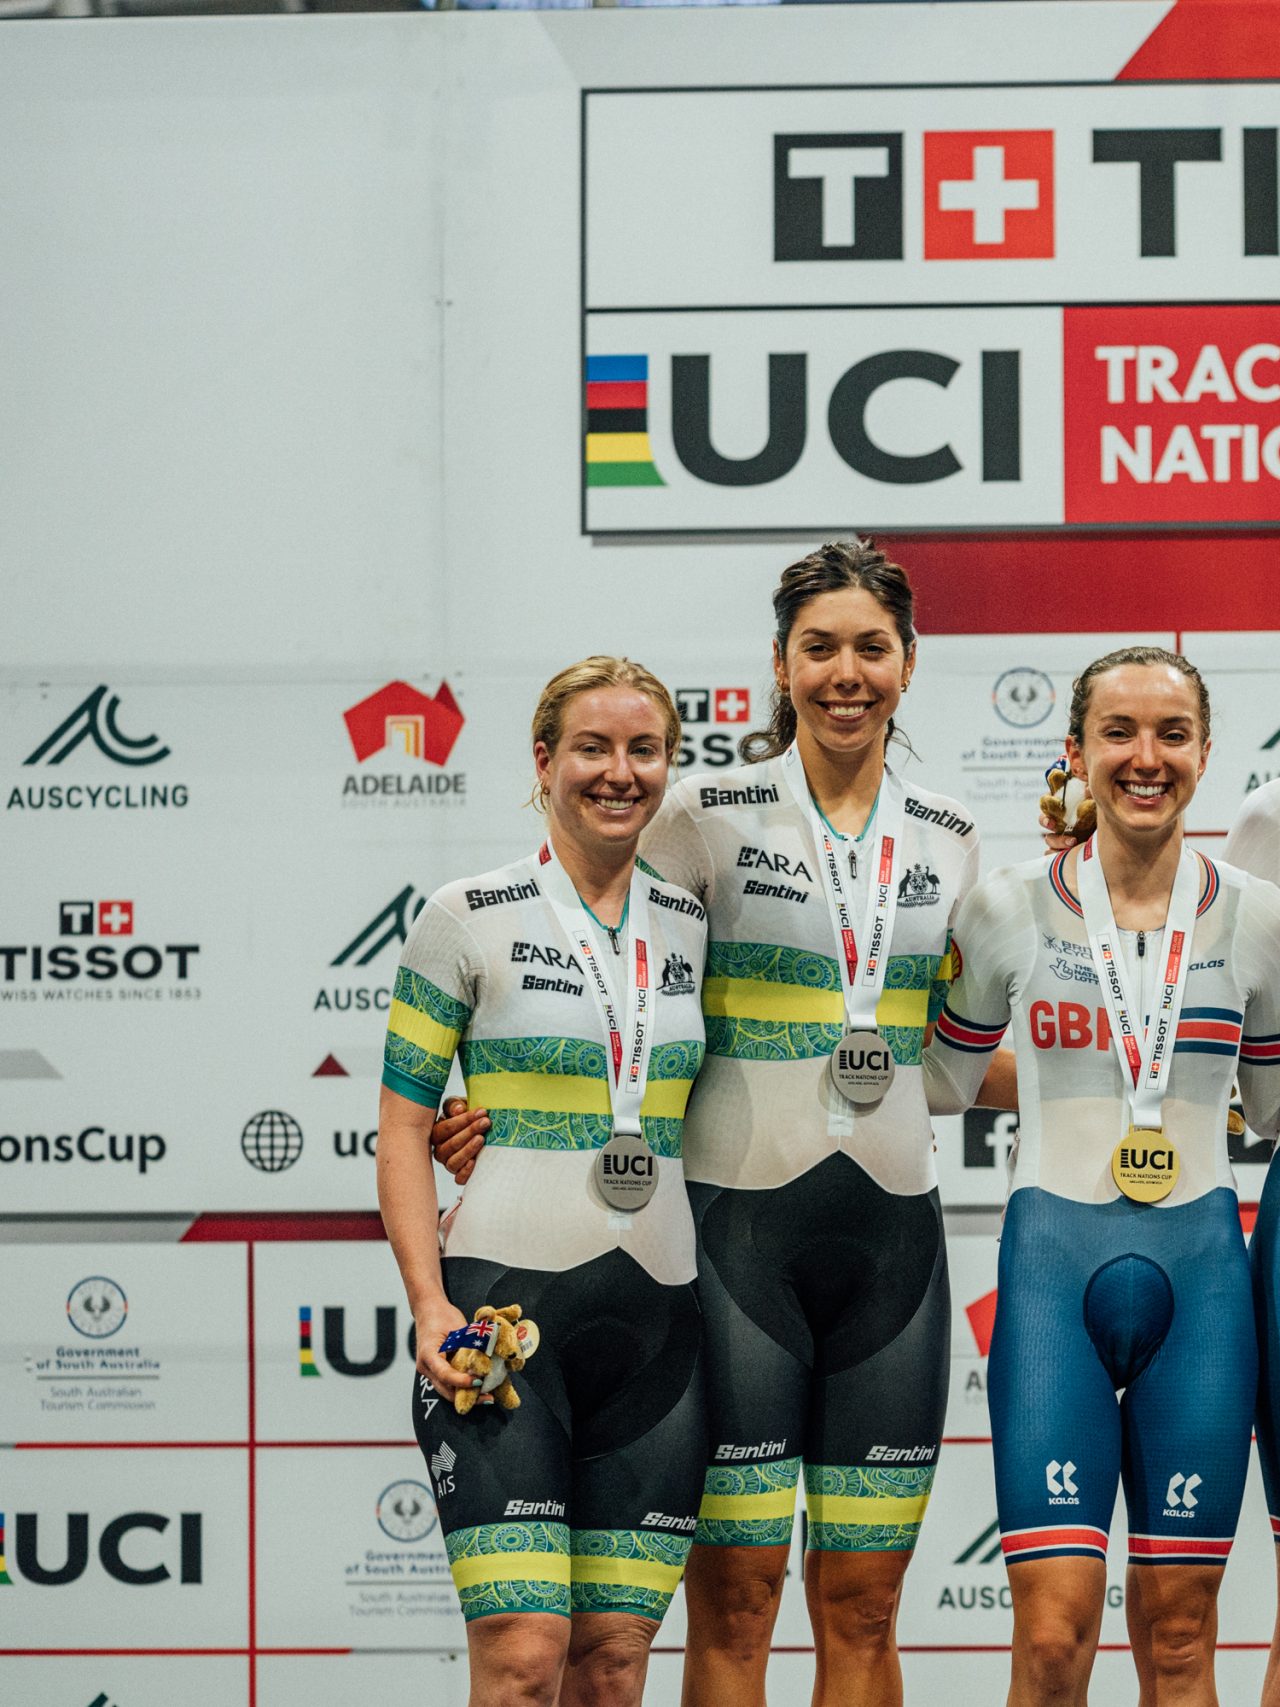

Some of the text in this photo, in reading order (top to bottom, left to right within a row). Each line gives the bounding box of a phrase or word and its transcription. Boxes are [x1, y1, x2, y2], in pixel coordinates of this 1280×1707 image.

[669, 348, 1022, 486] UCI
[342, 773, 466, 795] ADELAIDE
[700, 784, 780, 809] Santini
[7, 785, 189, 810] AUSCYCLING
[904, 797, 976, 838] Santini
[827, 851, 843, 894] TISSOT
[465, 879, 541, 911] Santini
[649, 887, 705, 922] Santini
[743, 879, 810, 905] Santini
[869, 916, 884, 960] TISSOT
[0, 944, 201, 981] TISSOT
[1074, 963, 1093, 972] THE
[522, 975, 584, 998] Santini
[587, 956, 609, 996] TISSOT
[1105, 960, 1123, 1002] TISSOT
[42, 989, 113, 1000] WATCHES
[119, 988, 163, 999] SINCE
[632, 1021, 646, 1065] TISSOT
[1152, 1018, 1168, 1062] TISSOT
[848, 1050, 890, 1071] UCI
[612, 1154, 654, 1176] UCI
[1130, 1149, 1175, 1170] UCI
[36, 1359, 161, 1370] of South Australia
[55, 1346, 140, 1358] Government
[715, 1438, 787, 1461] Santini
[865, 1444, 936, 1463] Santini
[503, 1498, 566, 1518] Santini
[15, 1510, 204, 1586] UCI
[366, 1564, 404, 1575] South
